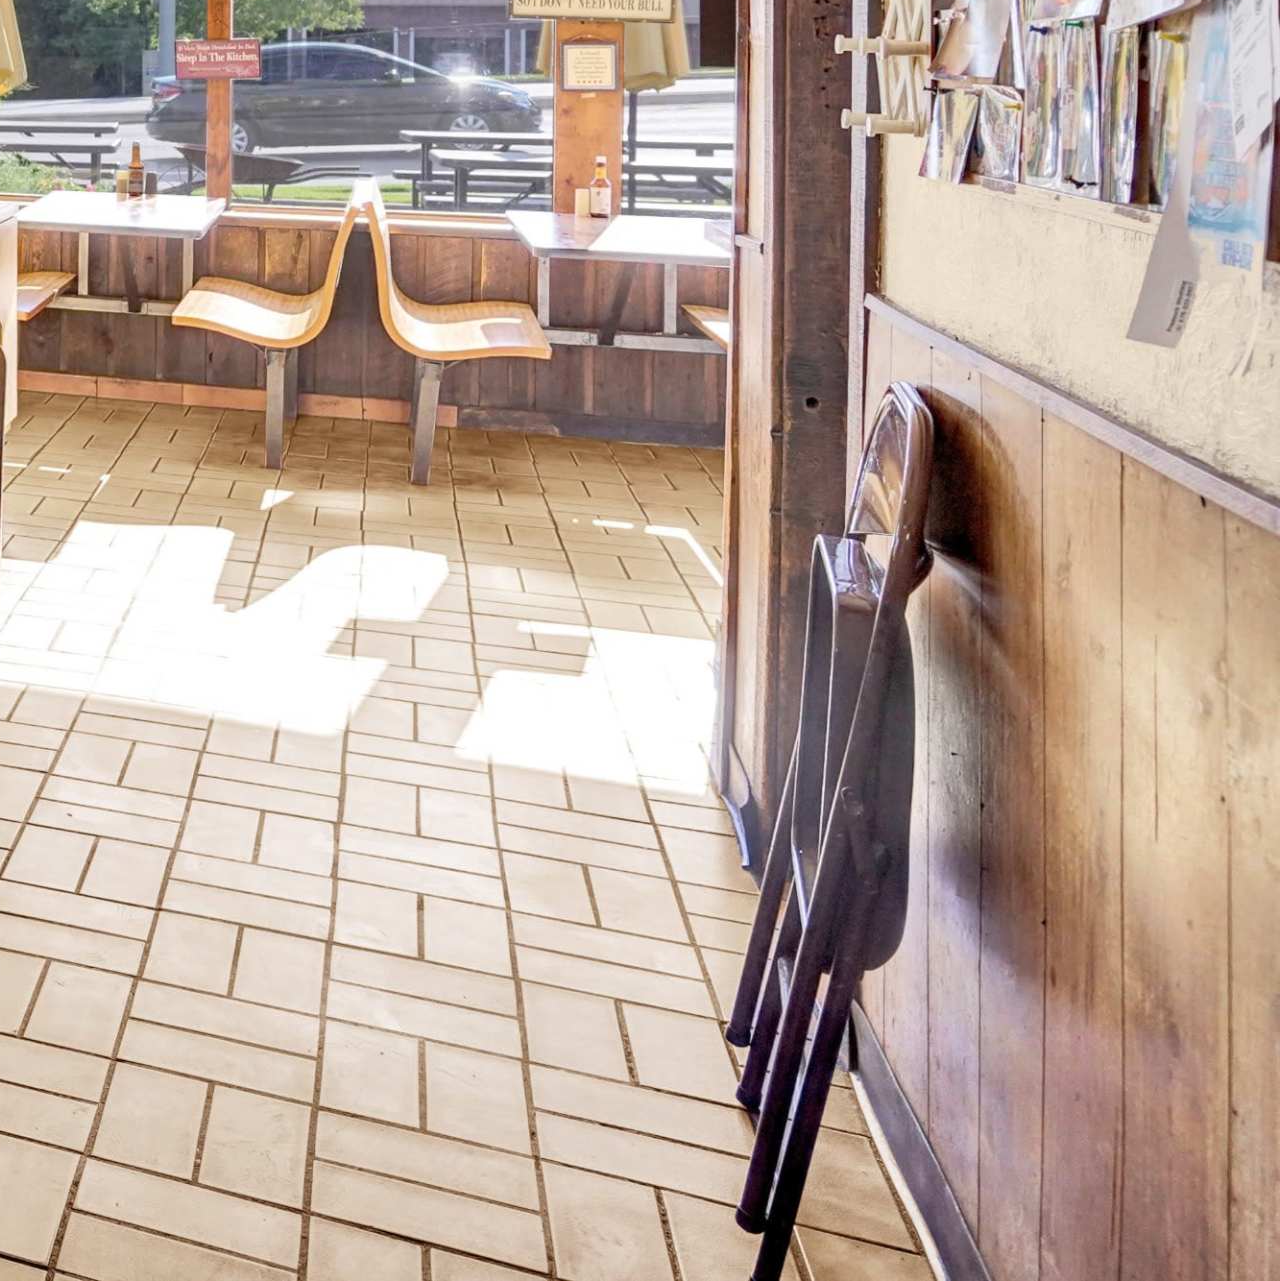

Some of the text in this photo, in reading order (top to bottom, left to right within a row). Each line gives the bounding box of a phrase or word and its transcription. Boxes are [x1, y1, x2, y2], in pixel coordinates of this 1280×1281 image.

[176, 53, 198, 65] Sleep
[199, 54, 208, 62] In
[208, 52, 225, 62] The
